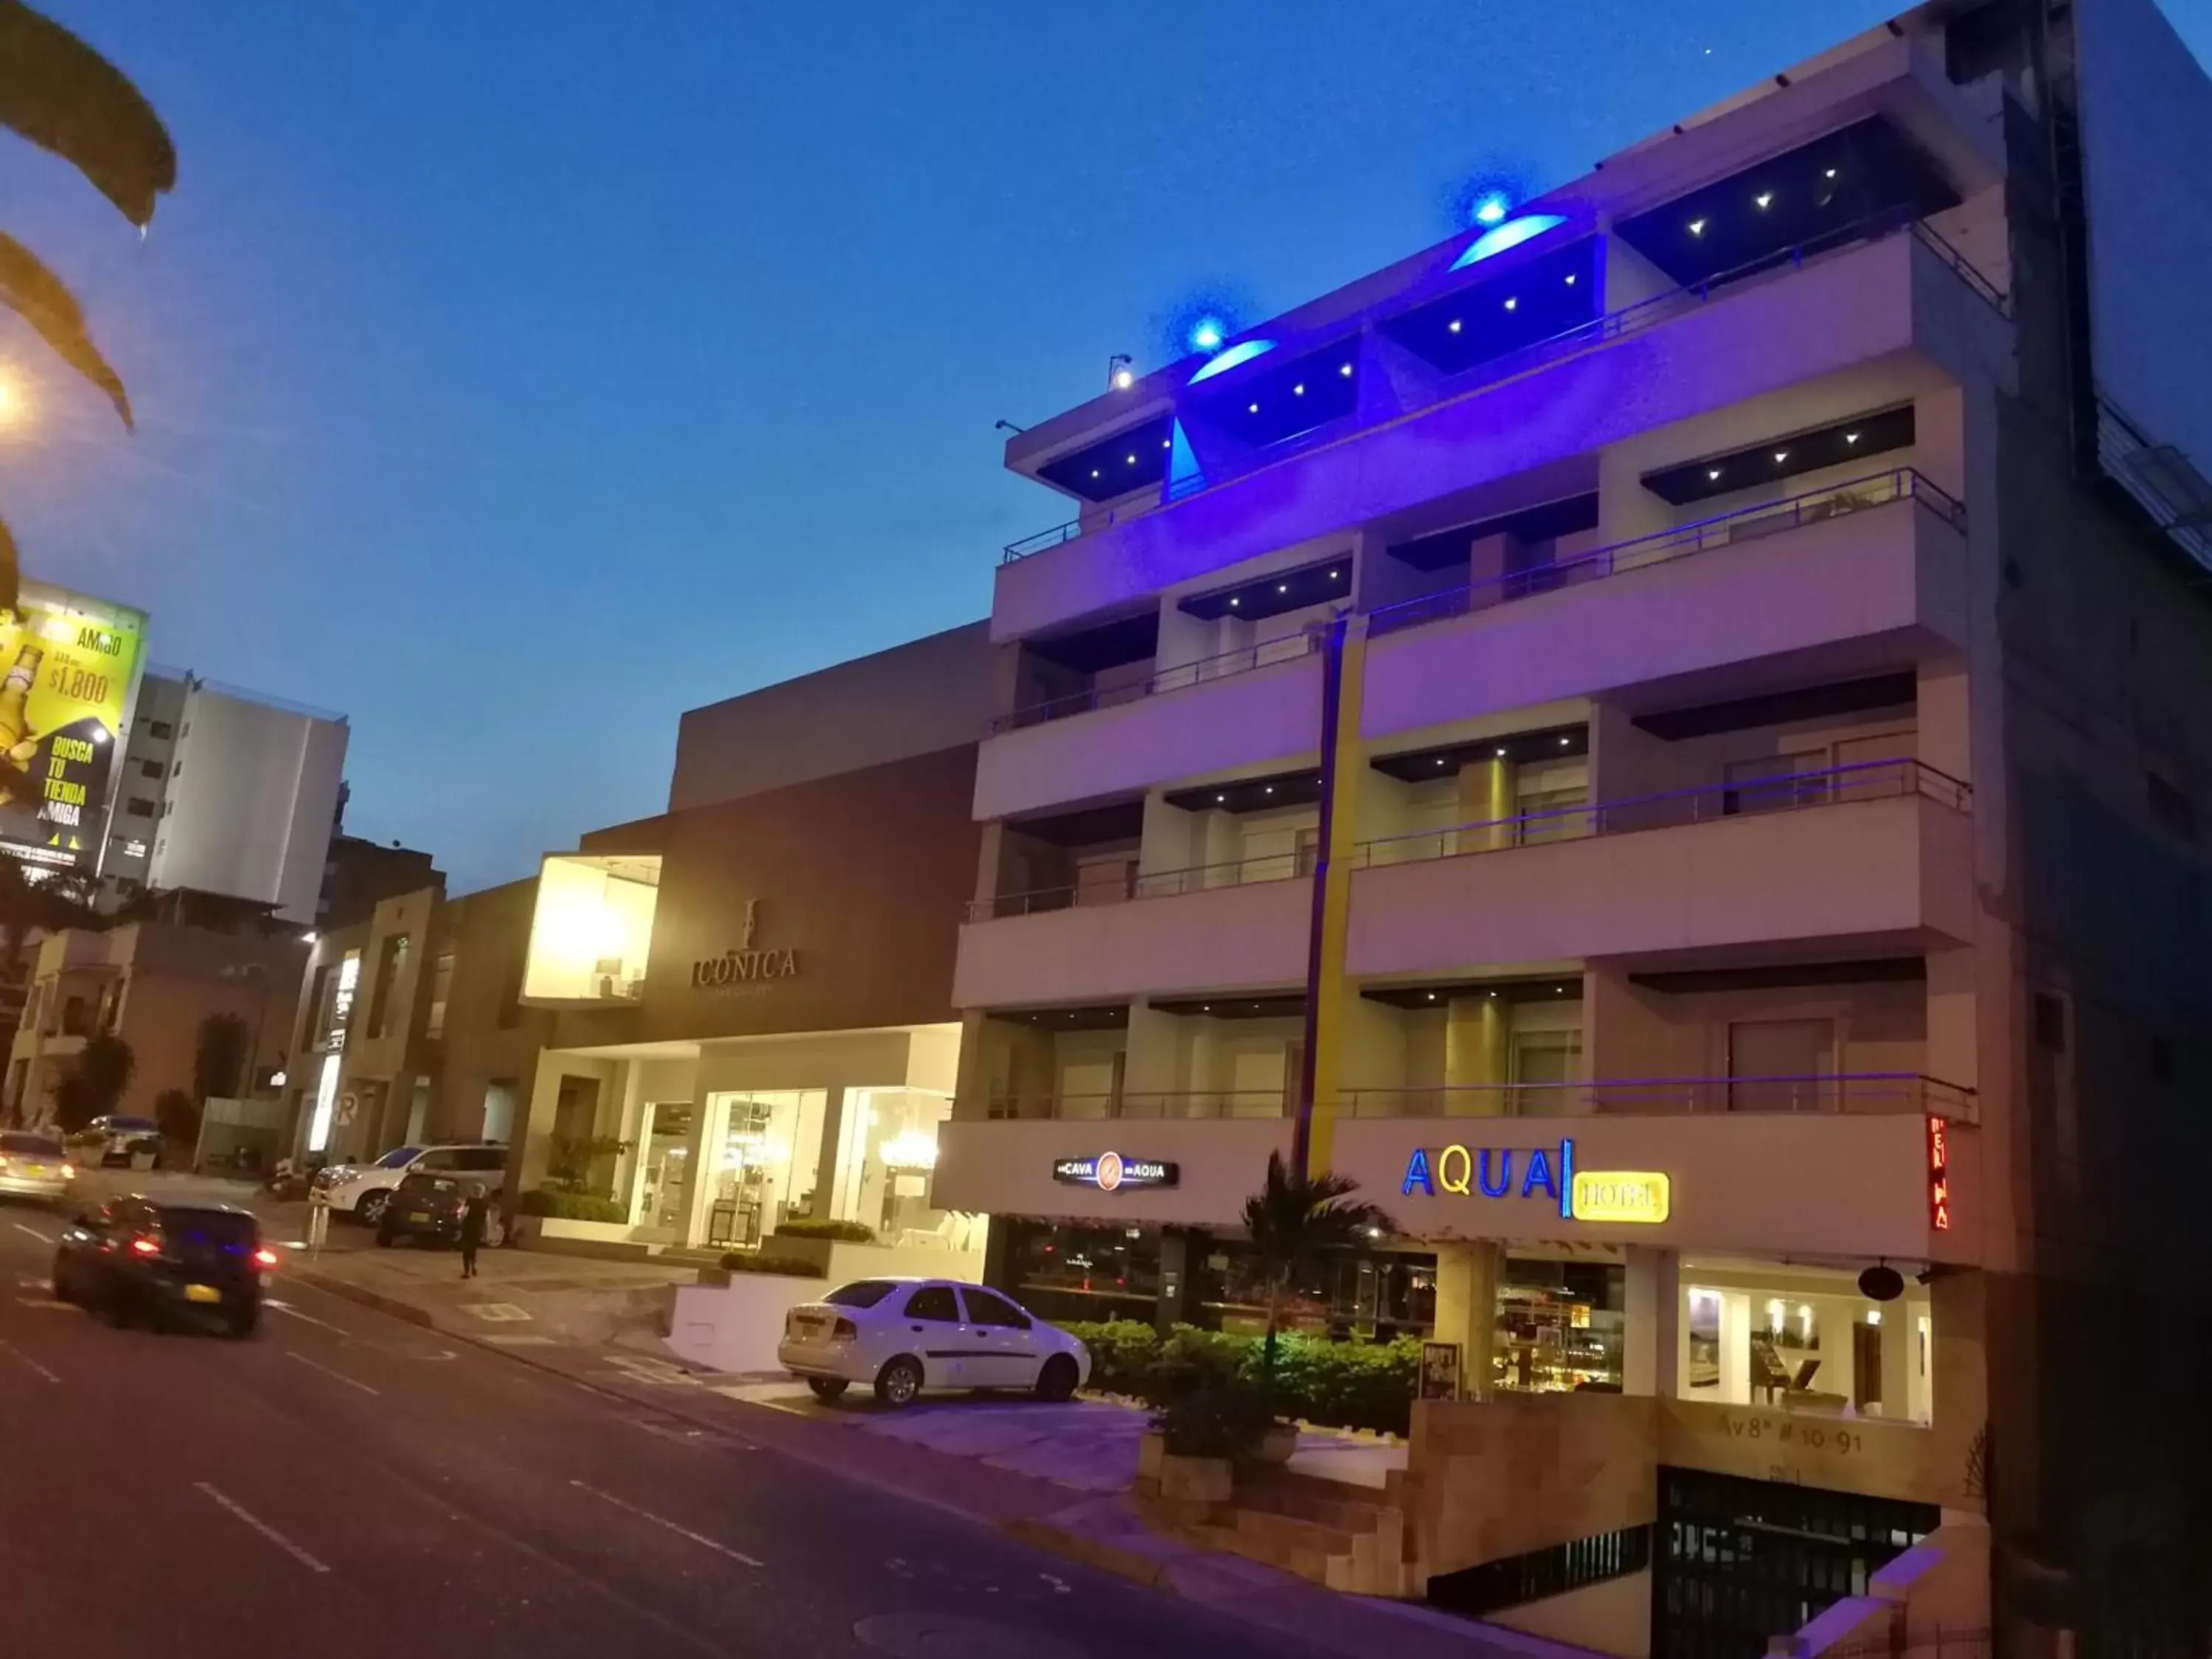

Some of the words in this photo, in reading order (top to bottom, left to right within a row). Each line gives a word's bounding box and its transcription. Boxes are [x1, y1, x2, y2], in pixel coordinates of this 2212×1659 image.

[52, 736, 94, 765] BUSCA
[49, 757, 66, 779] TU
[44, 778, 86, 806] TIENDA
[36, 799, 80, 827] AMIGA
[1065, 1162, 1092, 1175] CAVA
[1402, 1144, 1558, 1198] AQUA
[1582, 1182, 1659, 1208] HOTEL
[1803, 1429, 1862, 1454] 10-91
